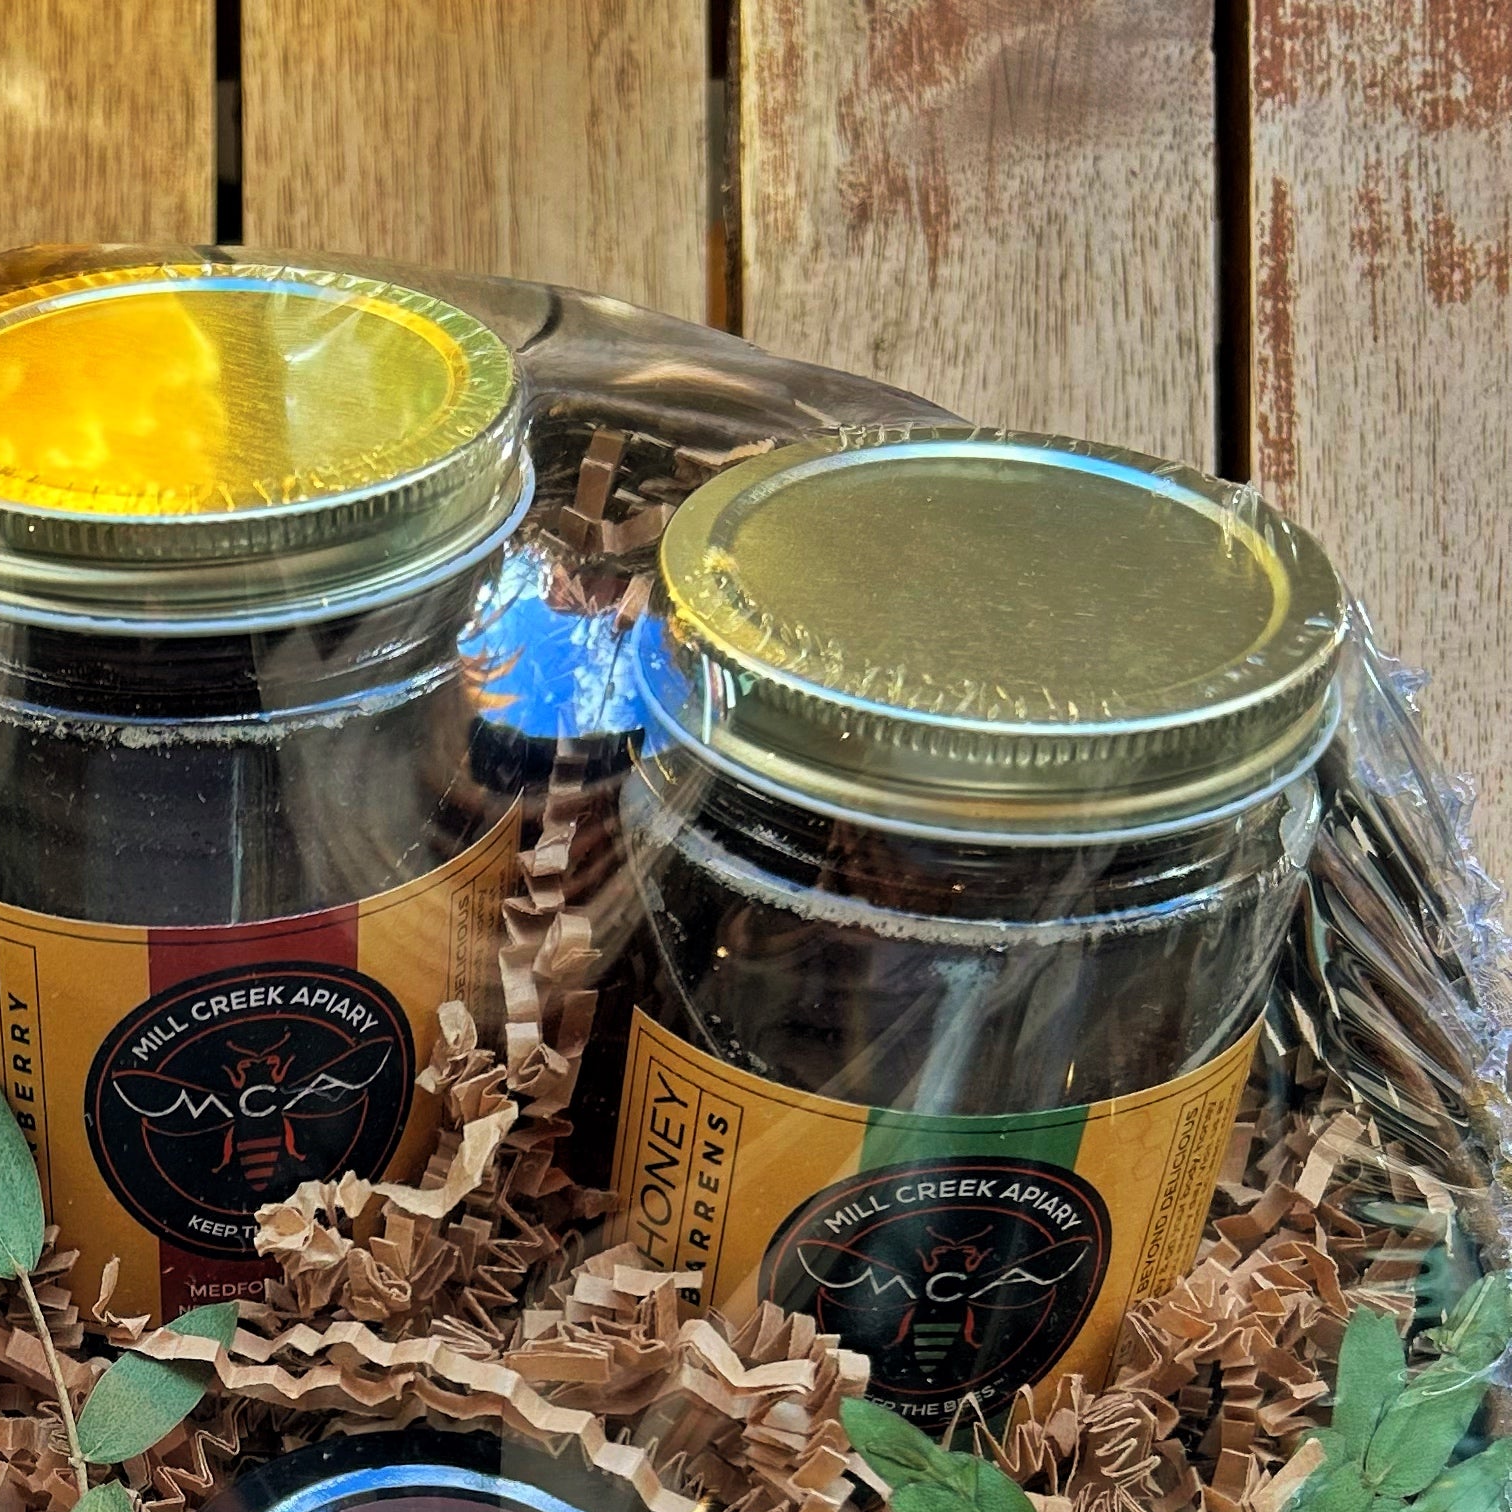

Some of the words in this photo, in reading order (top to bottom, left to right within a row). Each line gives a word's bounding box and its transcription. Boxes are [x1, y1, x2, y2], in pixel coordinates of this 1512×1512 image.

[131, 1014, 190, 1061] MILL
[191, 985, 286, 1021] CREEK
[288, 986, 379, 1034] APIARY
[7, 991, 38, 1160] BERRY
[637, 1071, 688, 1268] HONEY
[1136, 1215, 1168, 1294] BEYOND
[1159, 1106, 1198, 1211] DELICIOUS
[188, 1214, 238, 1238] KEEP
[824, 1194, 890, 1234] MILL
[895, 1179, 997, 1204] CREEK
[999, 1183, 1082, 1231] APIARY
[190, 1280, 264, 1299] MEDFO
[901, 1402, 939, 1416] THE
